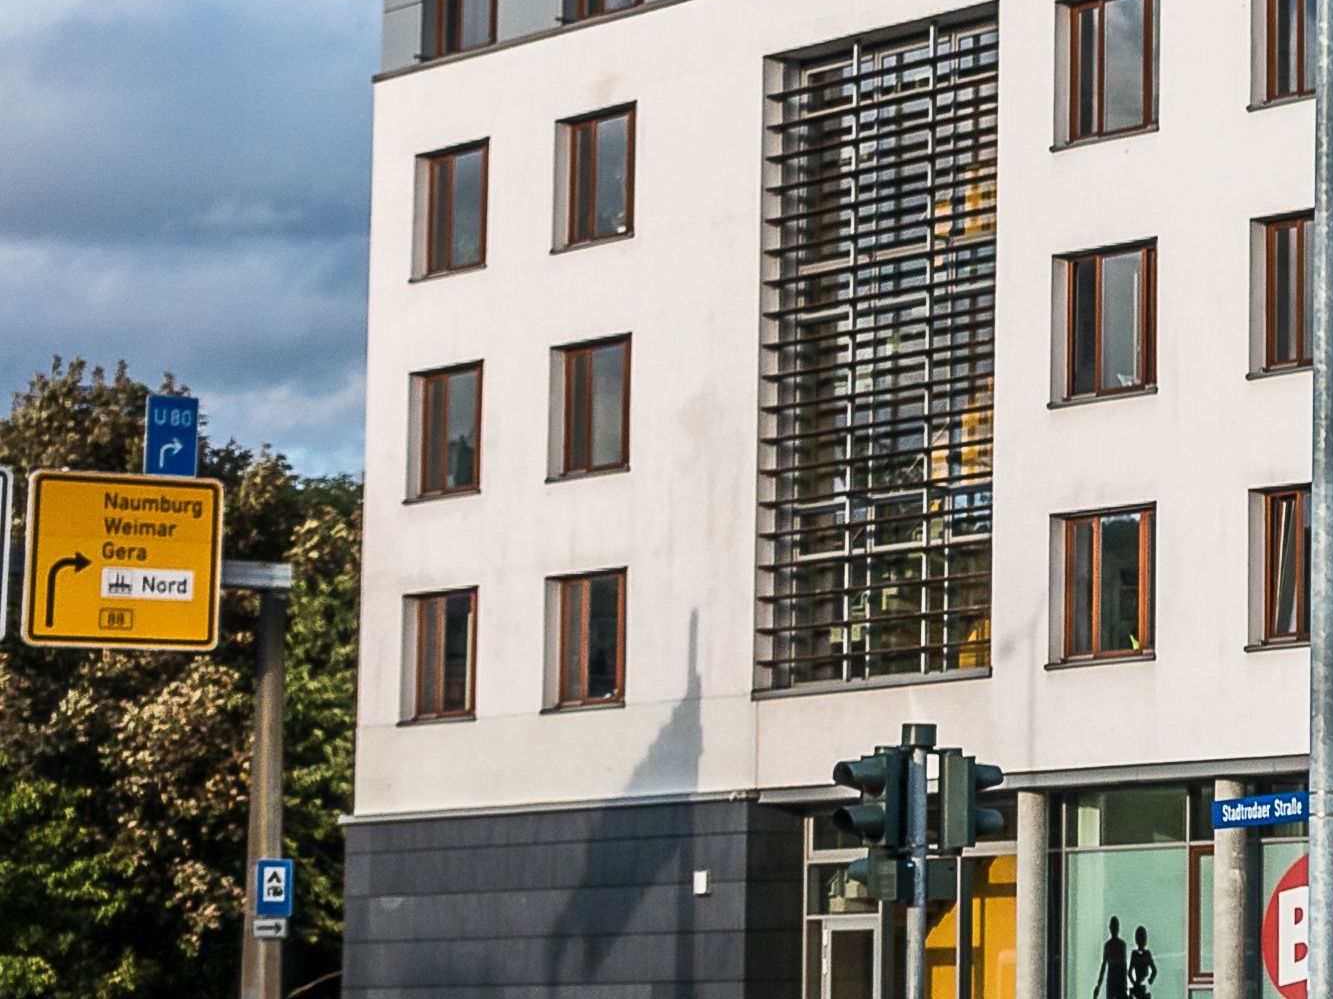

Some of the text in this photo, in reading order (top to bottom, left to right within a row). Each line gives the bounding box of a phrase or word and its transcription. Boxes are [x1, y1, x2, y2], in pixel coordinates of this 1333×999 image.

[104, 491, 204, 519] Naumburg
[104, 517, 178, 538] Weimar
[101, 541, 148, 562] Gera
[141, 575, 188, 595] Nord
[106, 612, 126, 627] 88
[1222, 797, 1303, 822] Stadtrodaer Straße
